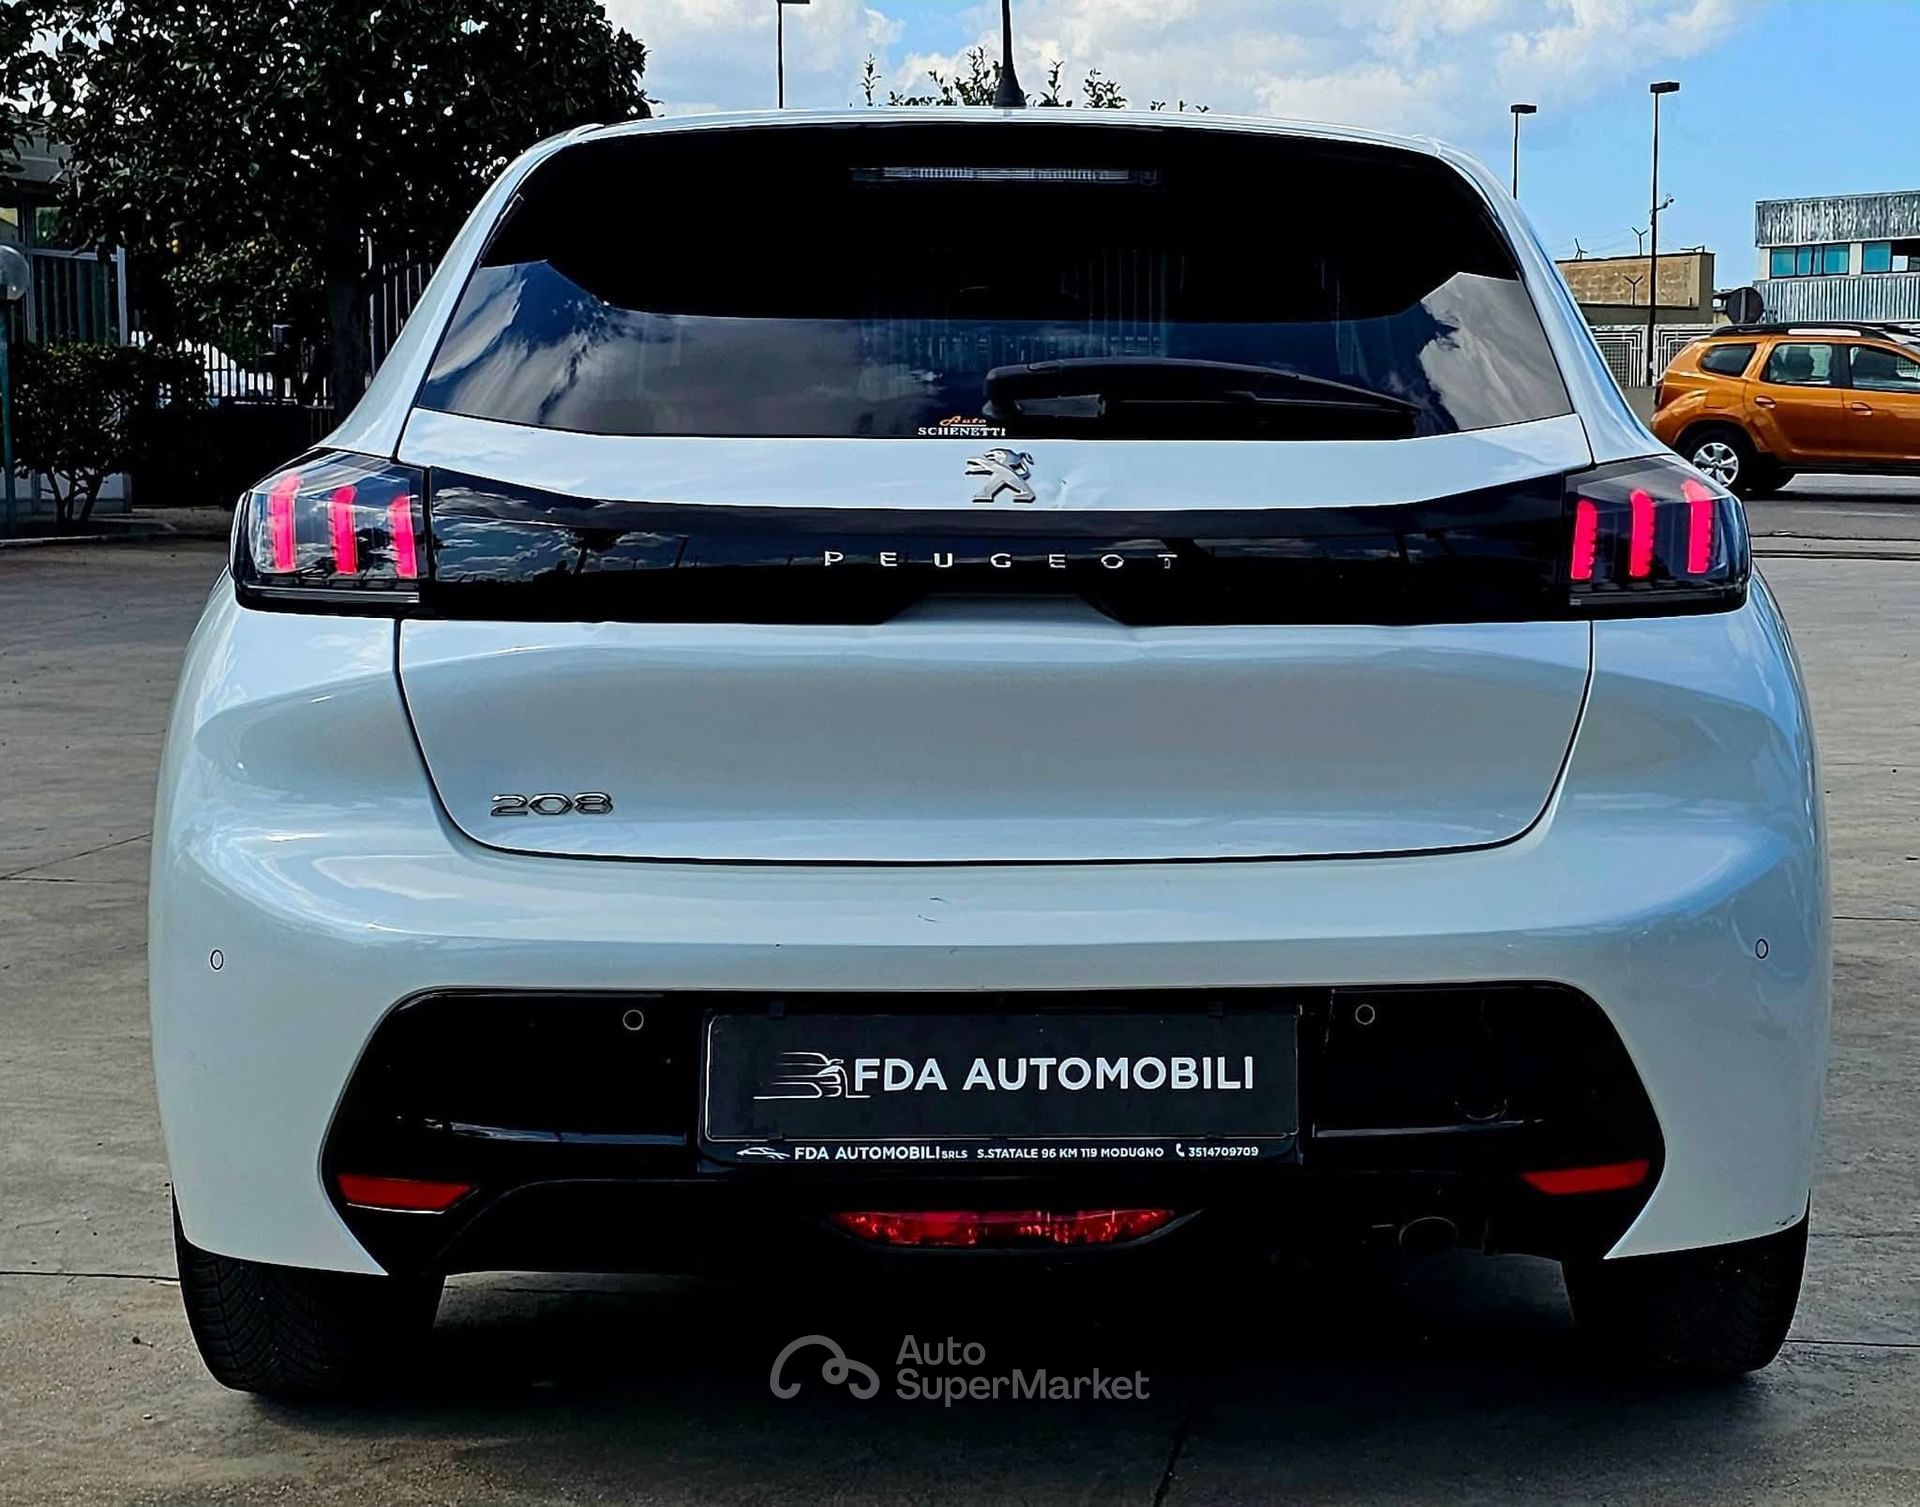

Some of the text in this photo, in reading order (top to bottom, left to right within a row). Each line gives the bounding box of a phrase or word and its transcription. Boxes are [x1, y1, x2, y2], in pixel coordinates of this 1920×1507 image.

[940, 415, 987, 426] Auto
[824, 551, 1178, 568] PEUGEOT
[490, 792, 614, 816] 208
[855, 1056, 1253, 1091] FDA AUTOMOBILI
[795, 1147, 829, 1160] FDA
[977, 1148, 1038, 1159] S.STATALE
[1041, 1149, 1056, 1158] 96
[1059, 1148, 1078, 1158] KM
[1101, 1148, 1164, 1158] MODUGNO
[1188, 1146, 1259, 1157] 3514709709
